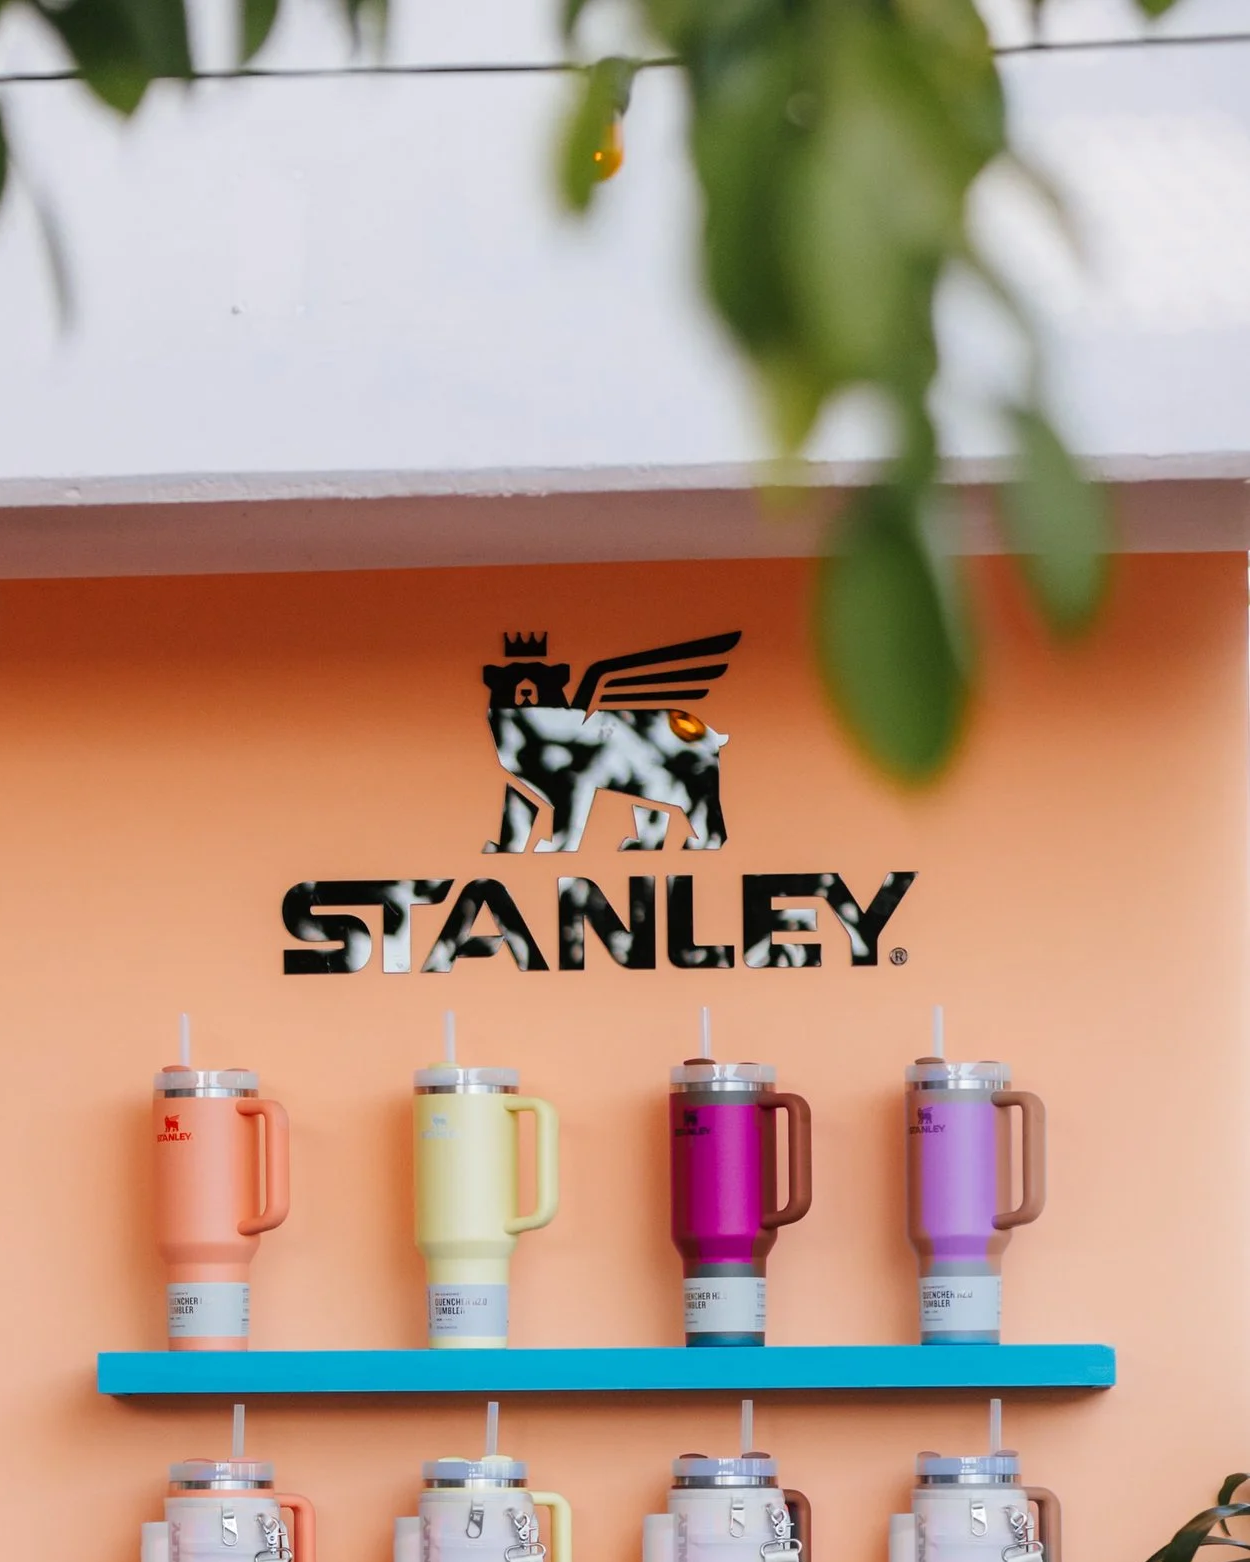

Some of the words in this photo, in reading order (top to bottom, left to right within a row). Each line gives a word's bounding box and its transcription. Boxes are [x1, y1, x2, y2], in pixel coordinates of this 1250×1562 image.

[909, 1124, 946, 1135] STANLEY
[156, 1132, 192, 1143] STANLEY
[922, 1299, 951, 1309] TUMBLER
